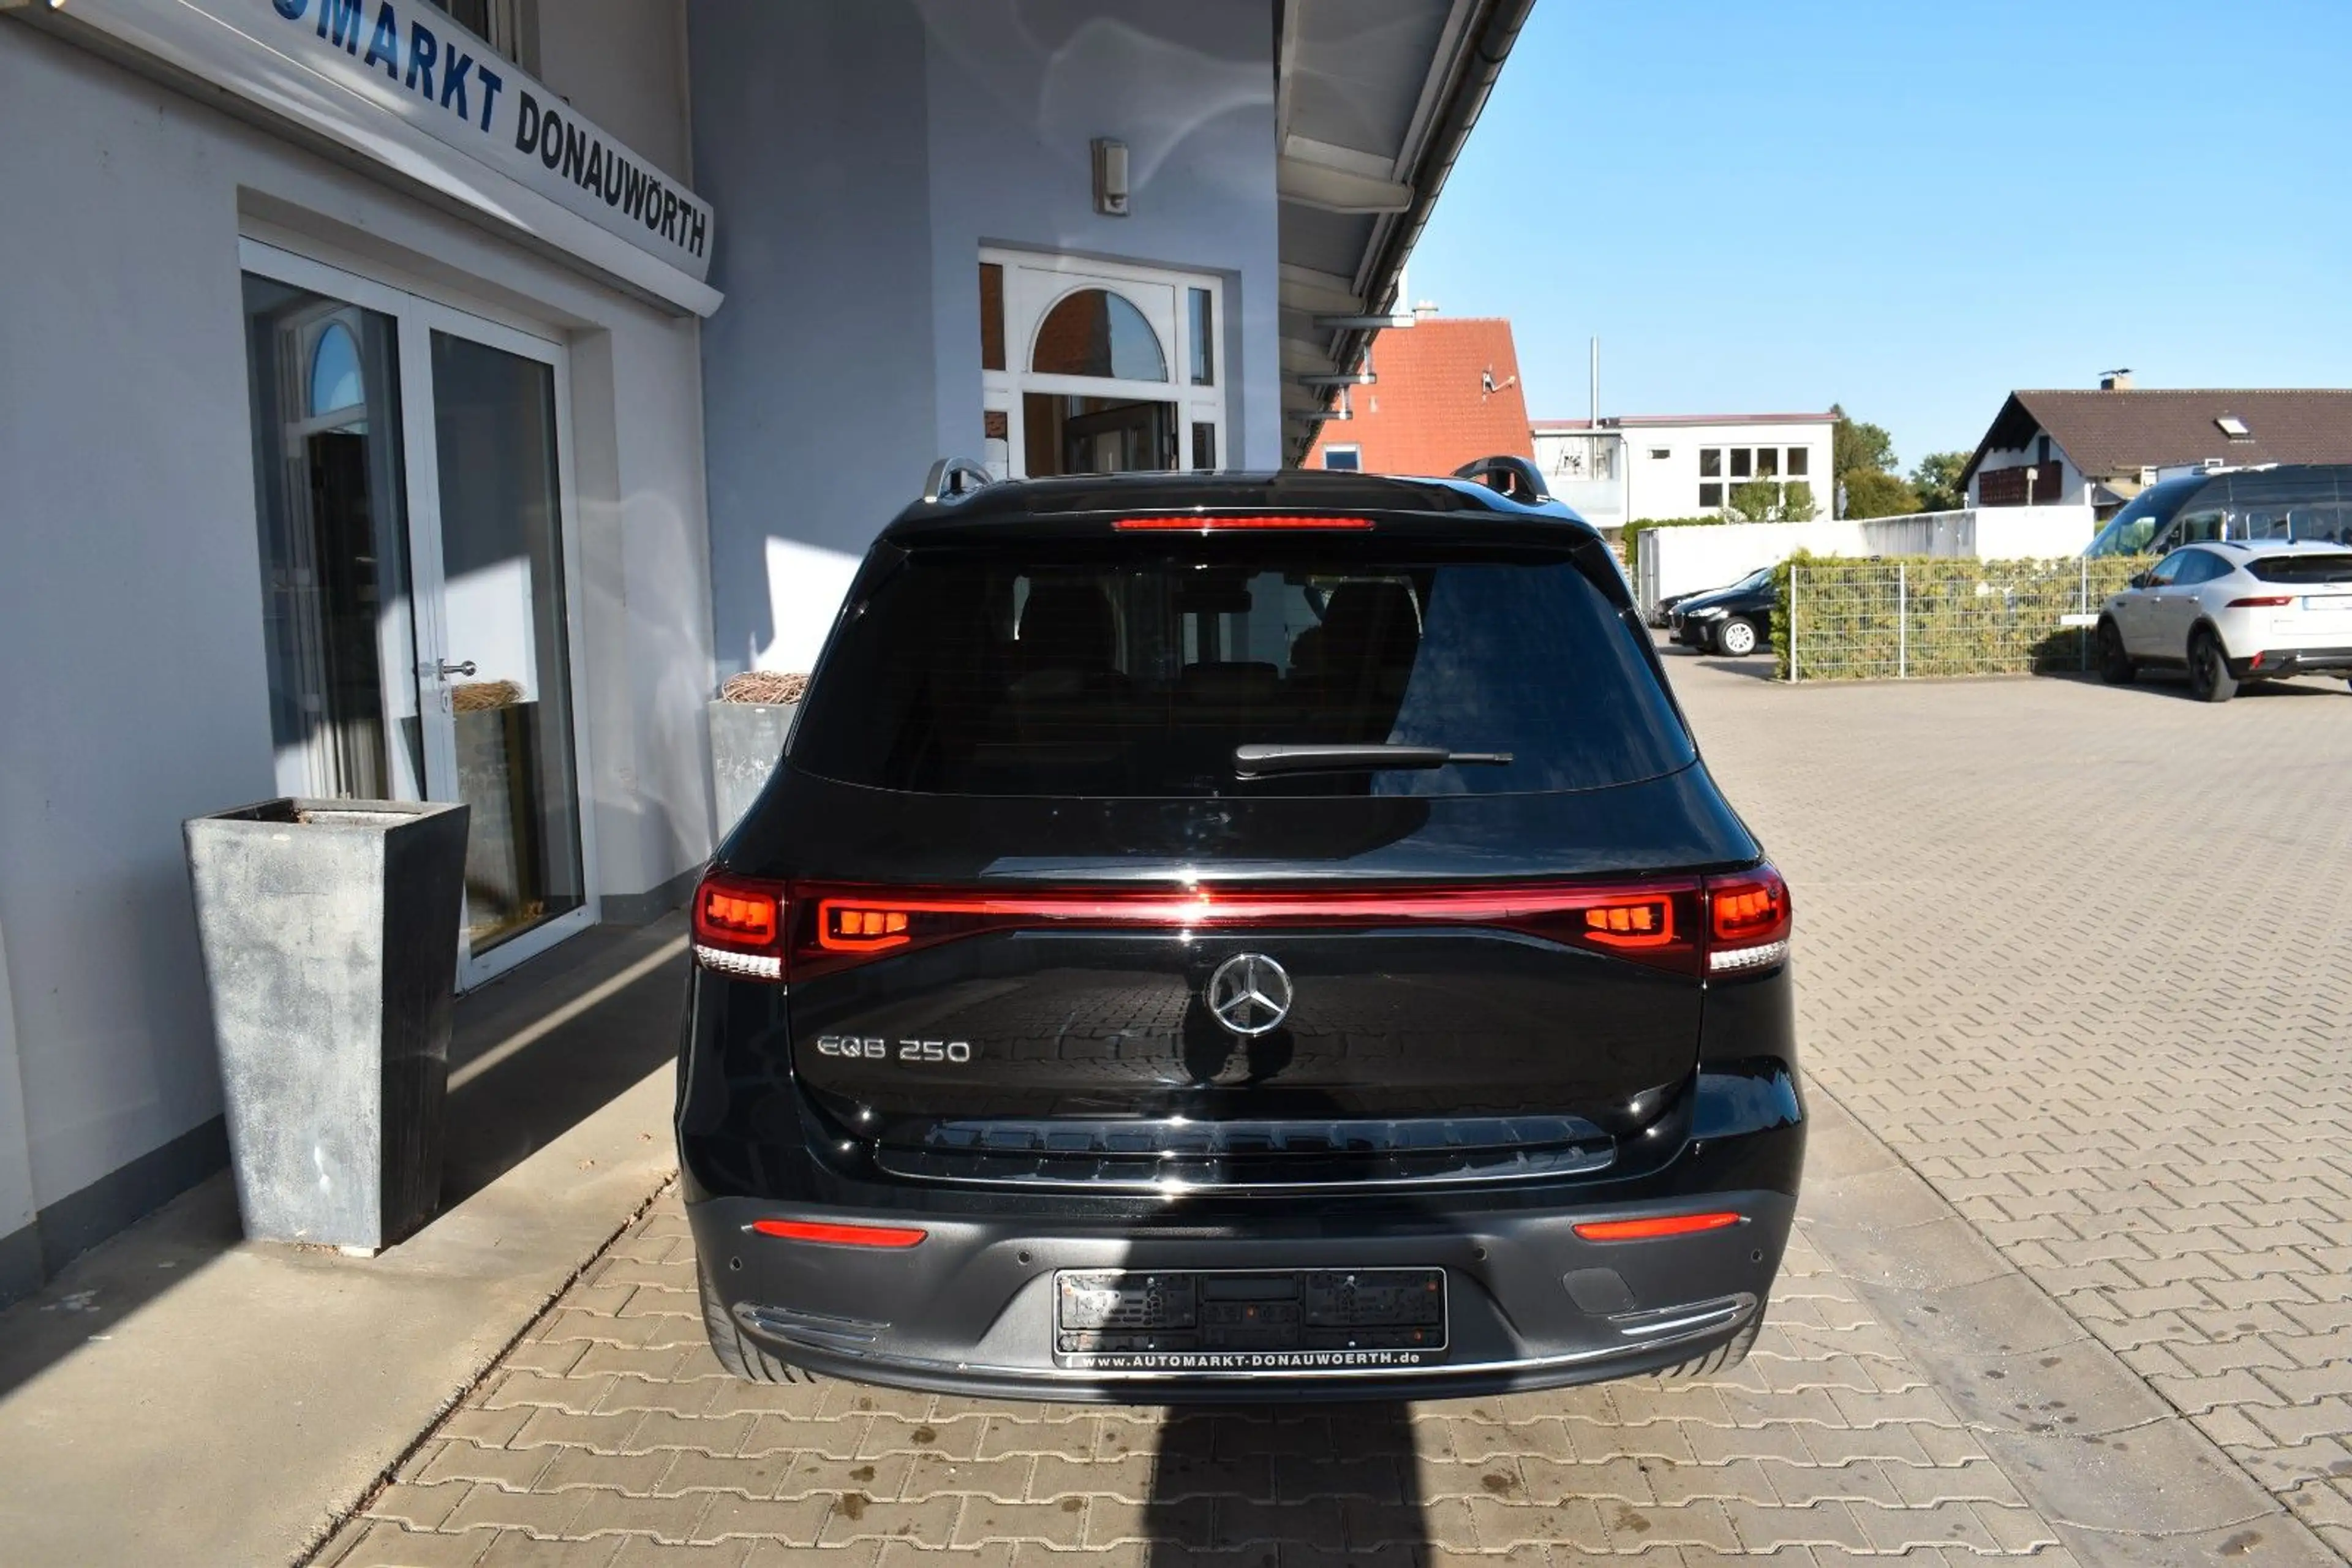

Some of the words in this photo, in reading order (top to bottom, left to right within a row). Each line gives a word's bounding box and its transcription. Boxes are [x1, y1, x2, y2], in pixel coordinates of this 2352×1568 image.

[515, 89, 706, 257] DONAUWÖRTH
[817, 1035, 886, 1058] EQB
[899, 1039, 970, 1061] 250
[1082, 1352, 1420, 1367] www.AUTOMARKT-DONAUWOERTH.de
